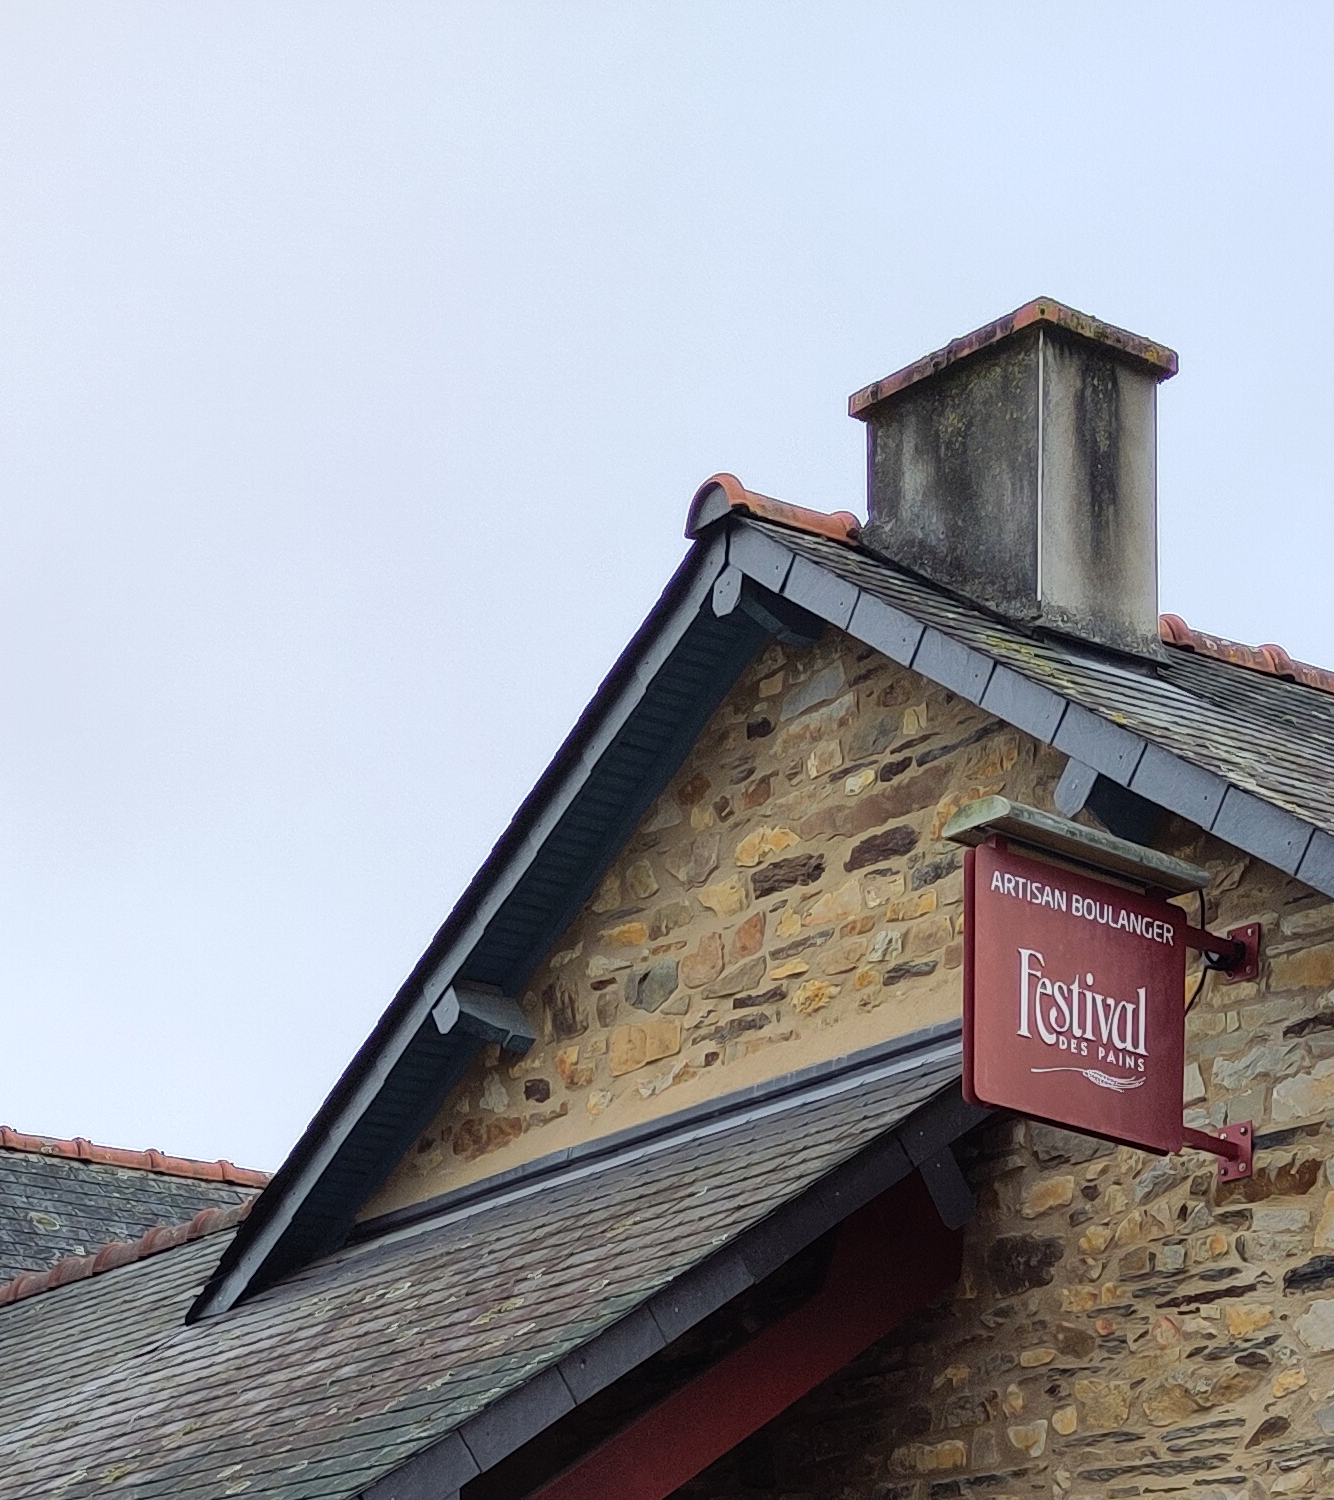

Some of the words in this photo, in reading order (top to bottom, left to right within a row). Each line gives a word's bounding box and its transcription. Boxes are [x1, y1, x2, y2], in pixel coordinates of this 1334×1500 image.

[990, 870, 1067, 912] ARTISAN
[1072, 894, 1174, 946] BOULANGER
[1016, 948, 1148, 1056] Festival
[1058, 1036, 1088, 1057] DES
[1098, 1045, 1146, 1072] PAINS
